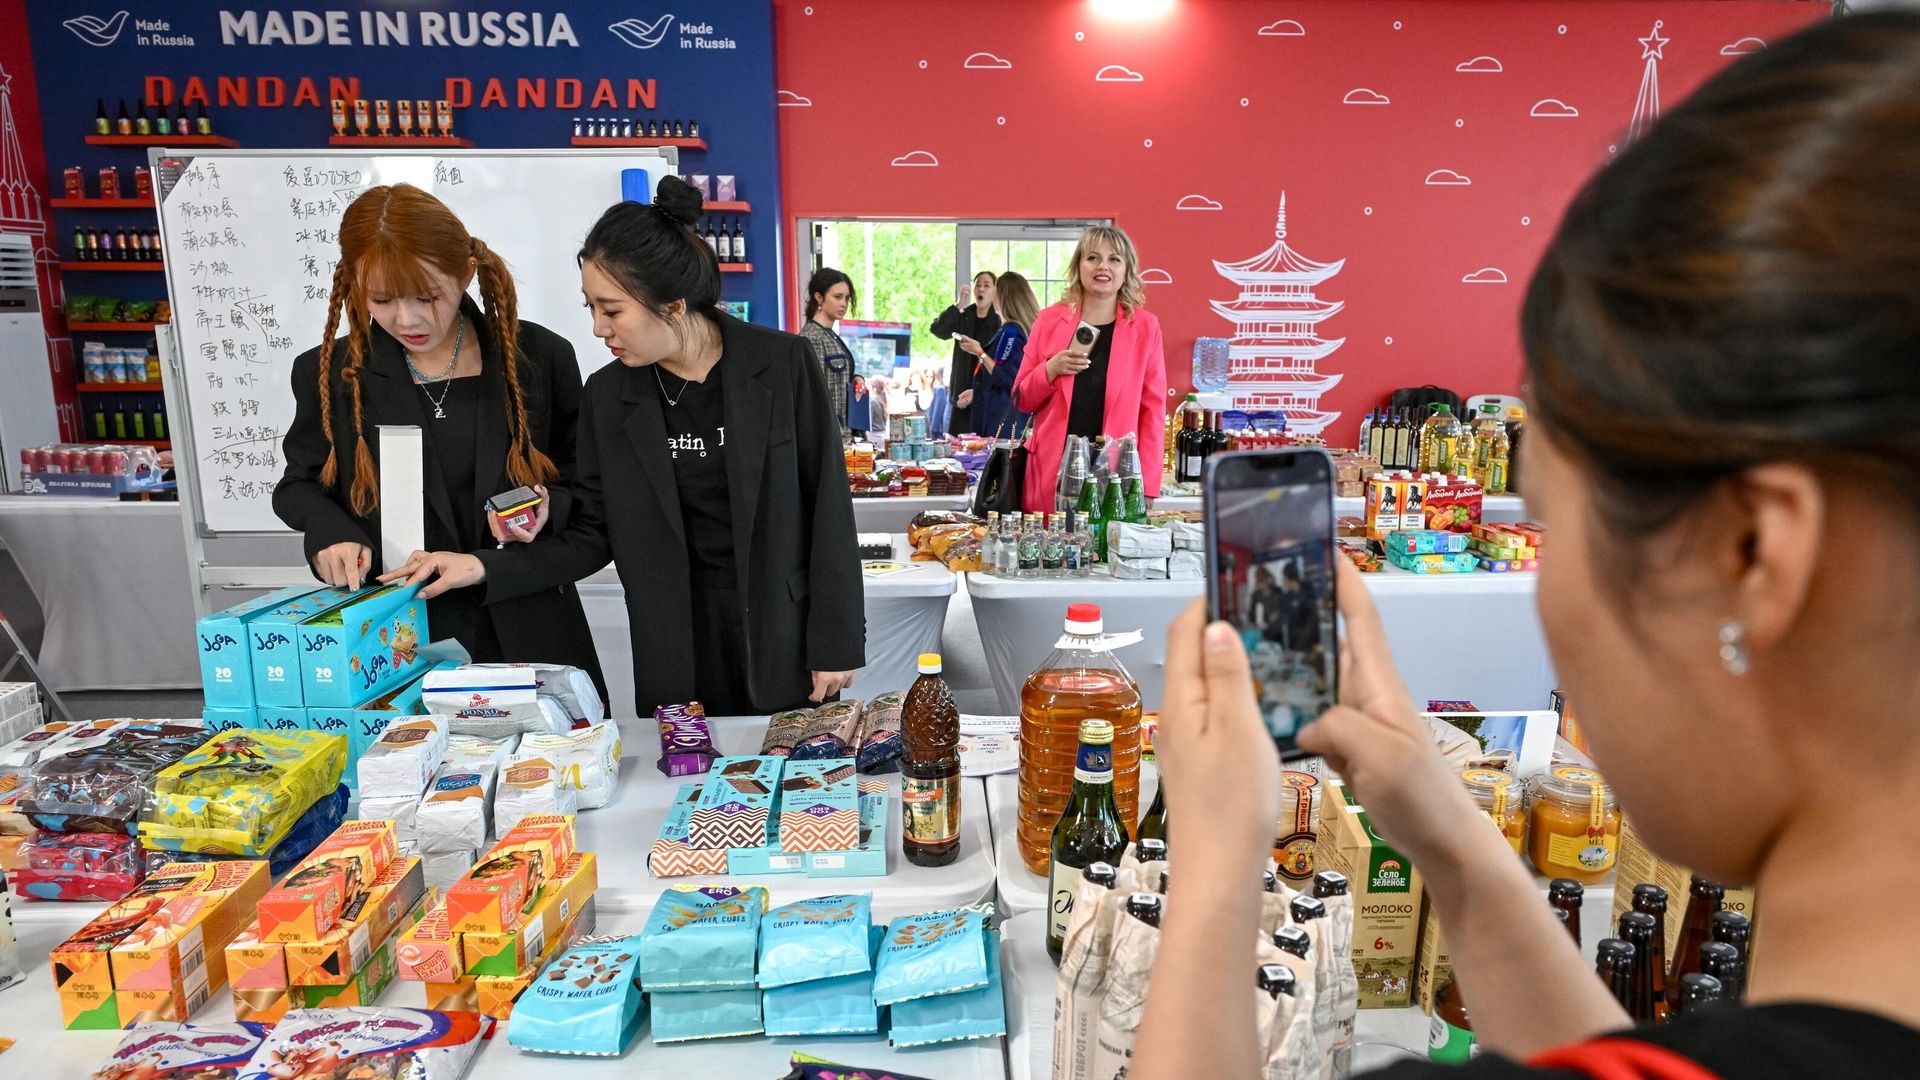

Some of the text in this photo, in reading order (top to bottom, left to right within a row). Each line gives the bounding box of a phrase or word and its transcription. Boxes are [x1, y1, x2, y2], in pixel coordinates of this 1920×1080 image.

[135, 19, 170, 31] Made
[219, 10, 580, 47] MADE IN RUSSIA
[679, 22, 713, 34] Made
[137, 34, 195, 46] in Russia
[680, 37, 737, 49] in Russia
[144, 76, 657, 109] DANDAN DANDAN
[296, 229, 340, 244] 冰淇
[215, 667, 232, 678] 20
[267, 666, 284, 677] 20
[315, 667, 332, 678] 20
[1378, 869, 1400, 879] Село
[1361, 904, 1413, 914] МОЛОКО
[773, 921, 800, 929] CRISPY
[536, 984, 619, 998] CRISPY WAFER CUBES
